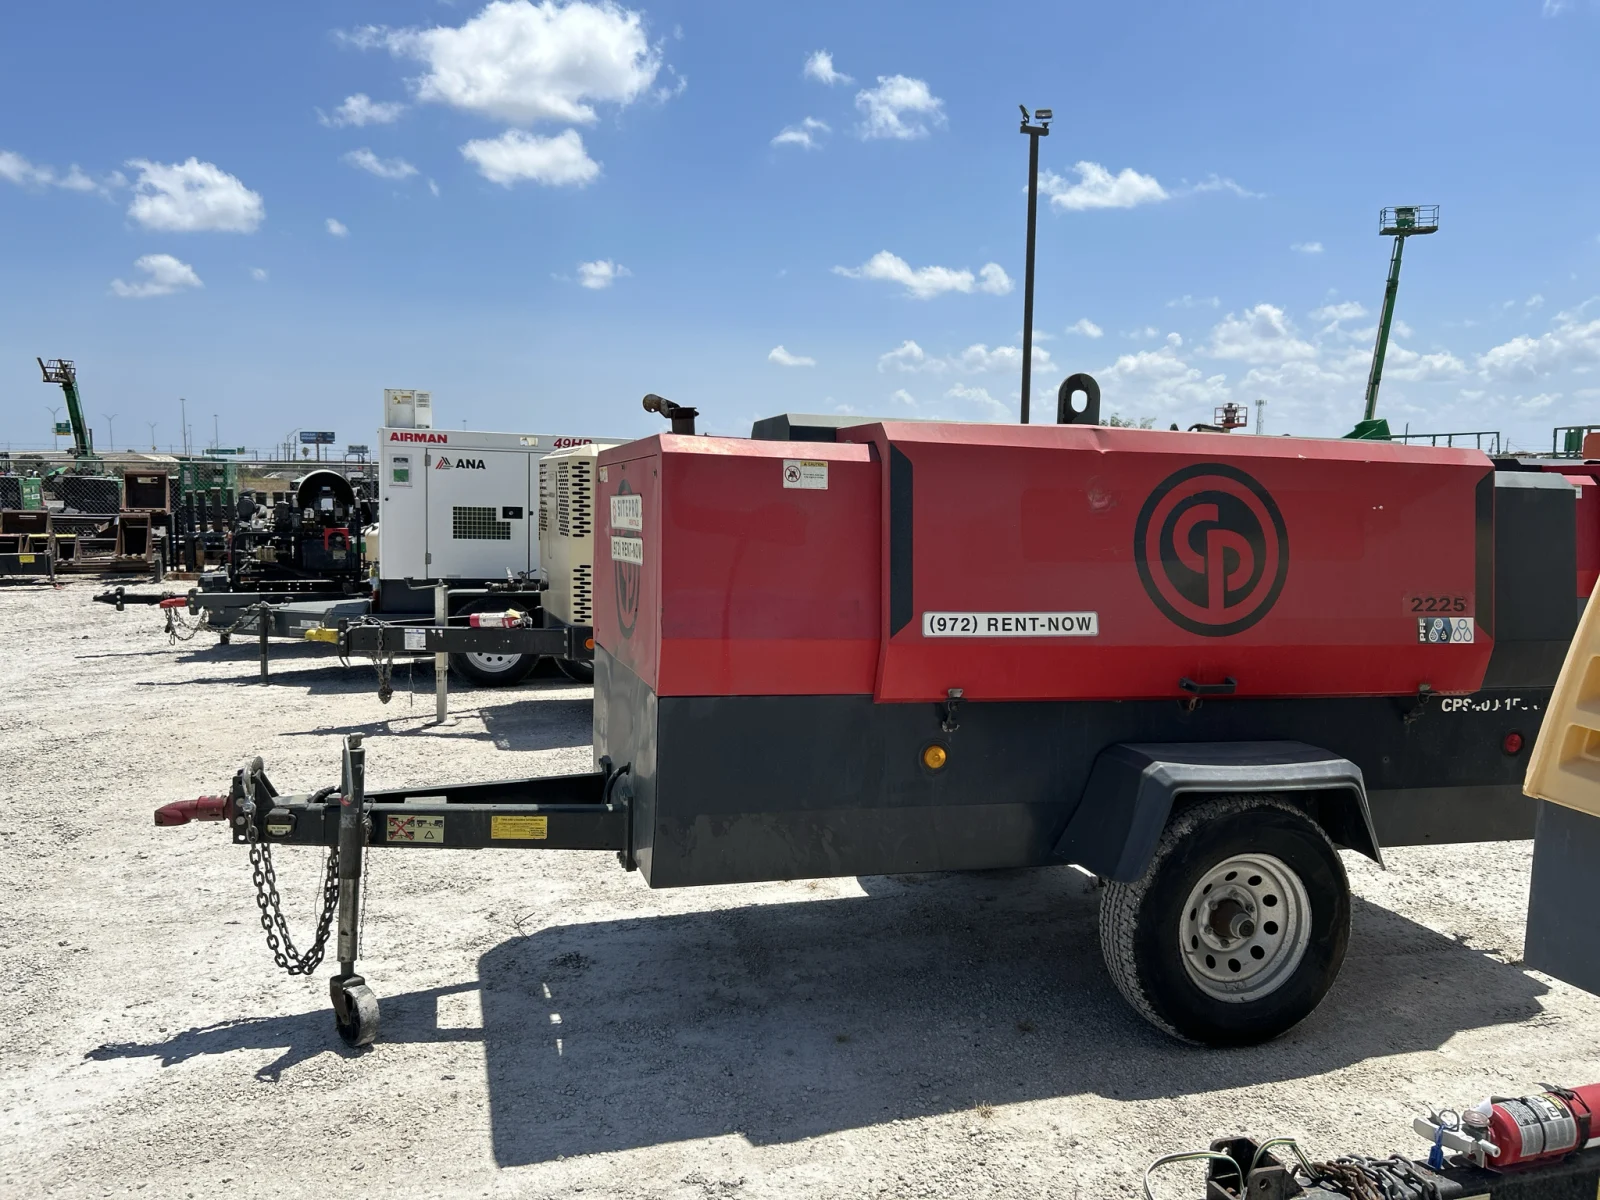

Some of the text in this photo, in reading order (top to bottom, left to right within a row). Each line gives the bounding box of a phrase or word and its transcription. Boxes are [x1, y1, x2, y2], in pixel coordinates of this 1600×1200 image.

[390, 432, 448, 443] AIRMAN
[455, 459, 486, 469] ANA
[617, 499, 639, 518] SITEPRO
[1411, 597, 1466, 612] 2225
[929, 615, 1092, 634] (972) RENT-NOW
[1419, 618, 1427, 642] PFF
